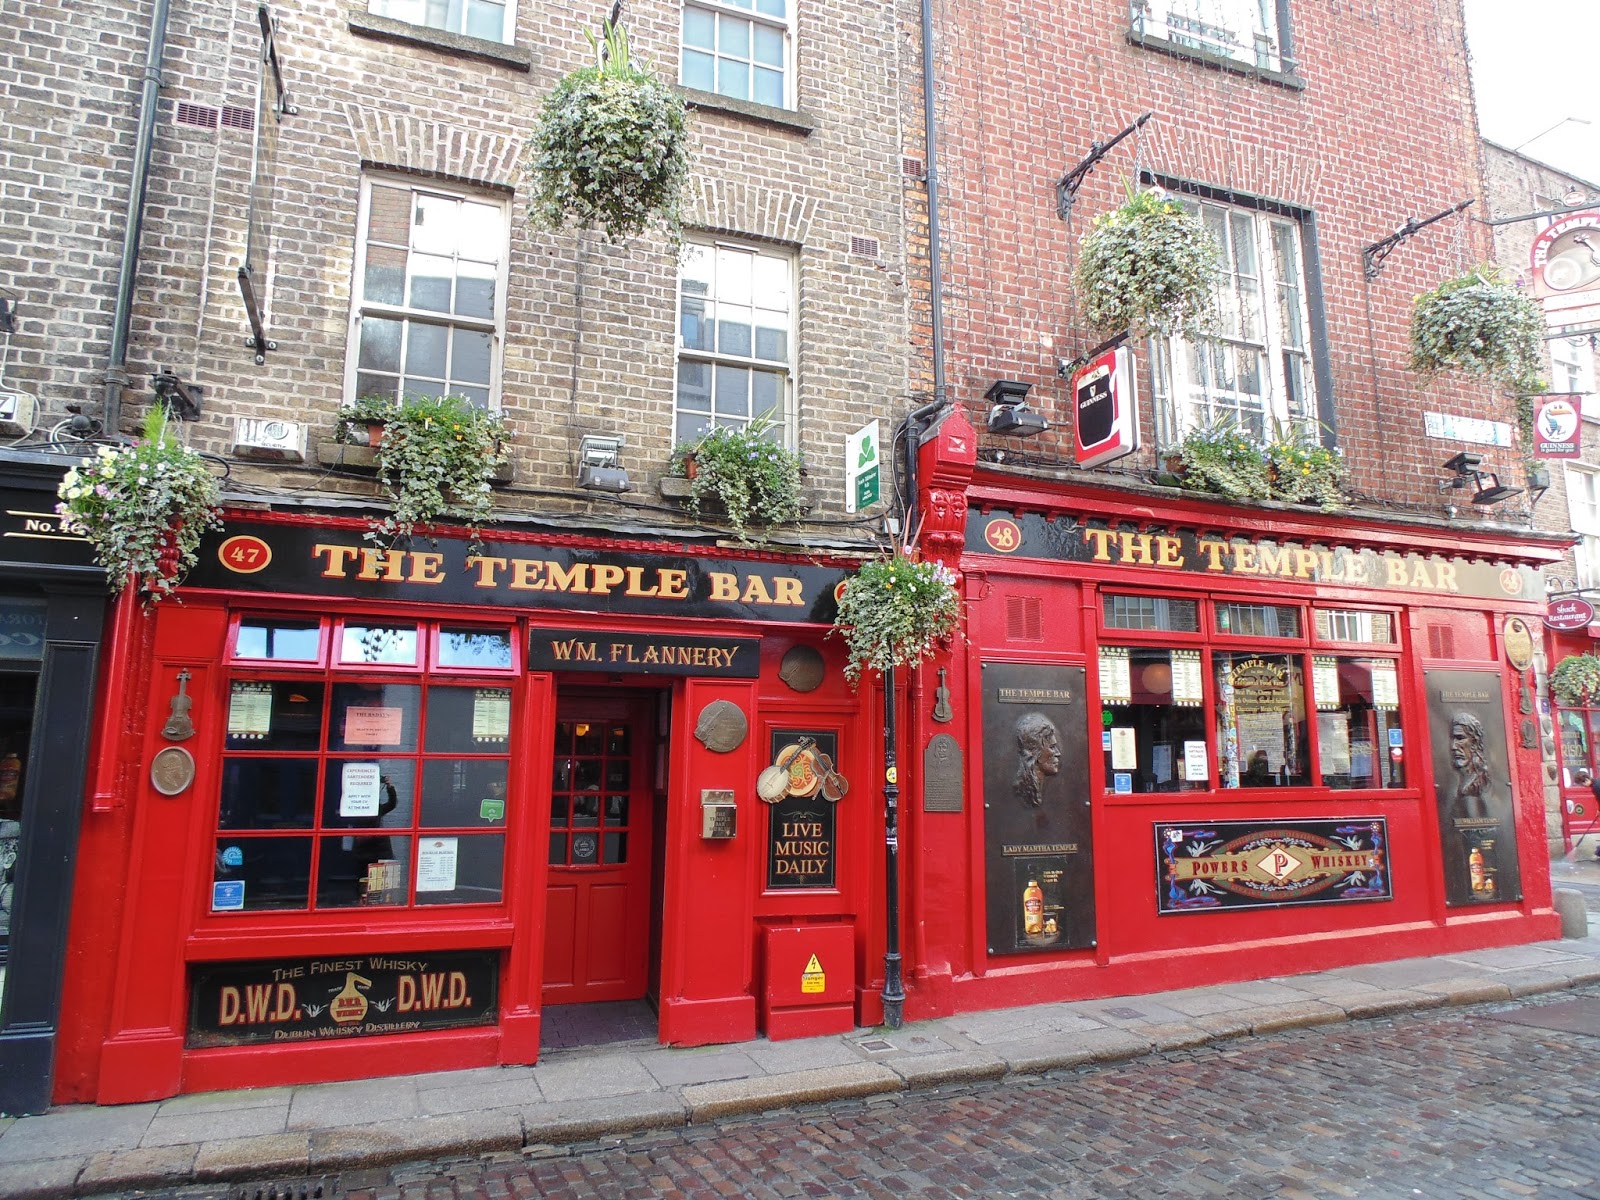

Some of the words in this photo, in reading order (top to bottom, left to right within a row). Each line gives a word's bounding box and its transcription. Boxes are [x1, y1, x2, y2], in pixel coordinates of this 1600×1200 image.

[1534, 239, 1551, 268] THE
[1080, 391, 1108, 409] GUINNESS
[25, 519, 56, 533] No.
[990, 526, 1014, 549] 48
[230, 546, 260, 563] 47
[1084, 528, 1186, 569] THE
[1199, 540, 1369, 583] TEMPLE
[1384, 556, 1460, 592] BAR
[311, 544, 447, 584] THE
[464, 555, 690, 600] TEMPLE
[708, 571, 806, 607] BAR
[1549, 612, 1587, 622] Restaurant
[1557, 603, 1577, 613] Shack
[551, 639, 603, 663] WM.
[610, 644, 740, 669] FLANNERY
[1231, 659, 1265, 678] TEMPLE
[1266, 662, 1284, 680] BAR
[1000, 689, 1017, 697] THE
[1020, 690, 1052, 698] TEMPLE
[1053, 690, 1071, 699] BAR
[782, 823, 822, 837] LIVE
[775, 841, 829, 856] MUSIC
[1003, 845, 1021, 853] LADY
[1023, 844, 1051, 852] MARTHA
[1052, 843, 1078, 851] TEMPLE
[775, 859, 828, 875] DAILY
[1192, 859, 1249, 876] POWERS
[1274, 852, 1289, 877] P
[1310, 854, 1368, 869] WHISKEY
[272, 965, 304, 982] THE
[310, 959, 364, 975] FINEST
[369, 956, 429, 972] WHISKY
[218, 983, 301, 1027] D.W.D.
[396, 971, 472, 1013] D.W.D.
[274, 1028, 317, 1040] DUBLIN
[319, 1024, 363, 1036] WHISKY
[365, 1020, 421, 1032] DISTILLERY
